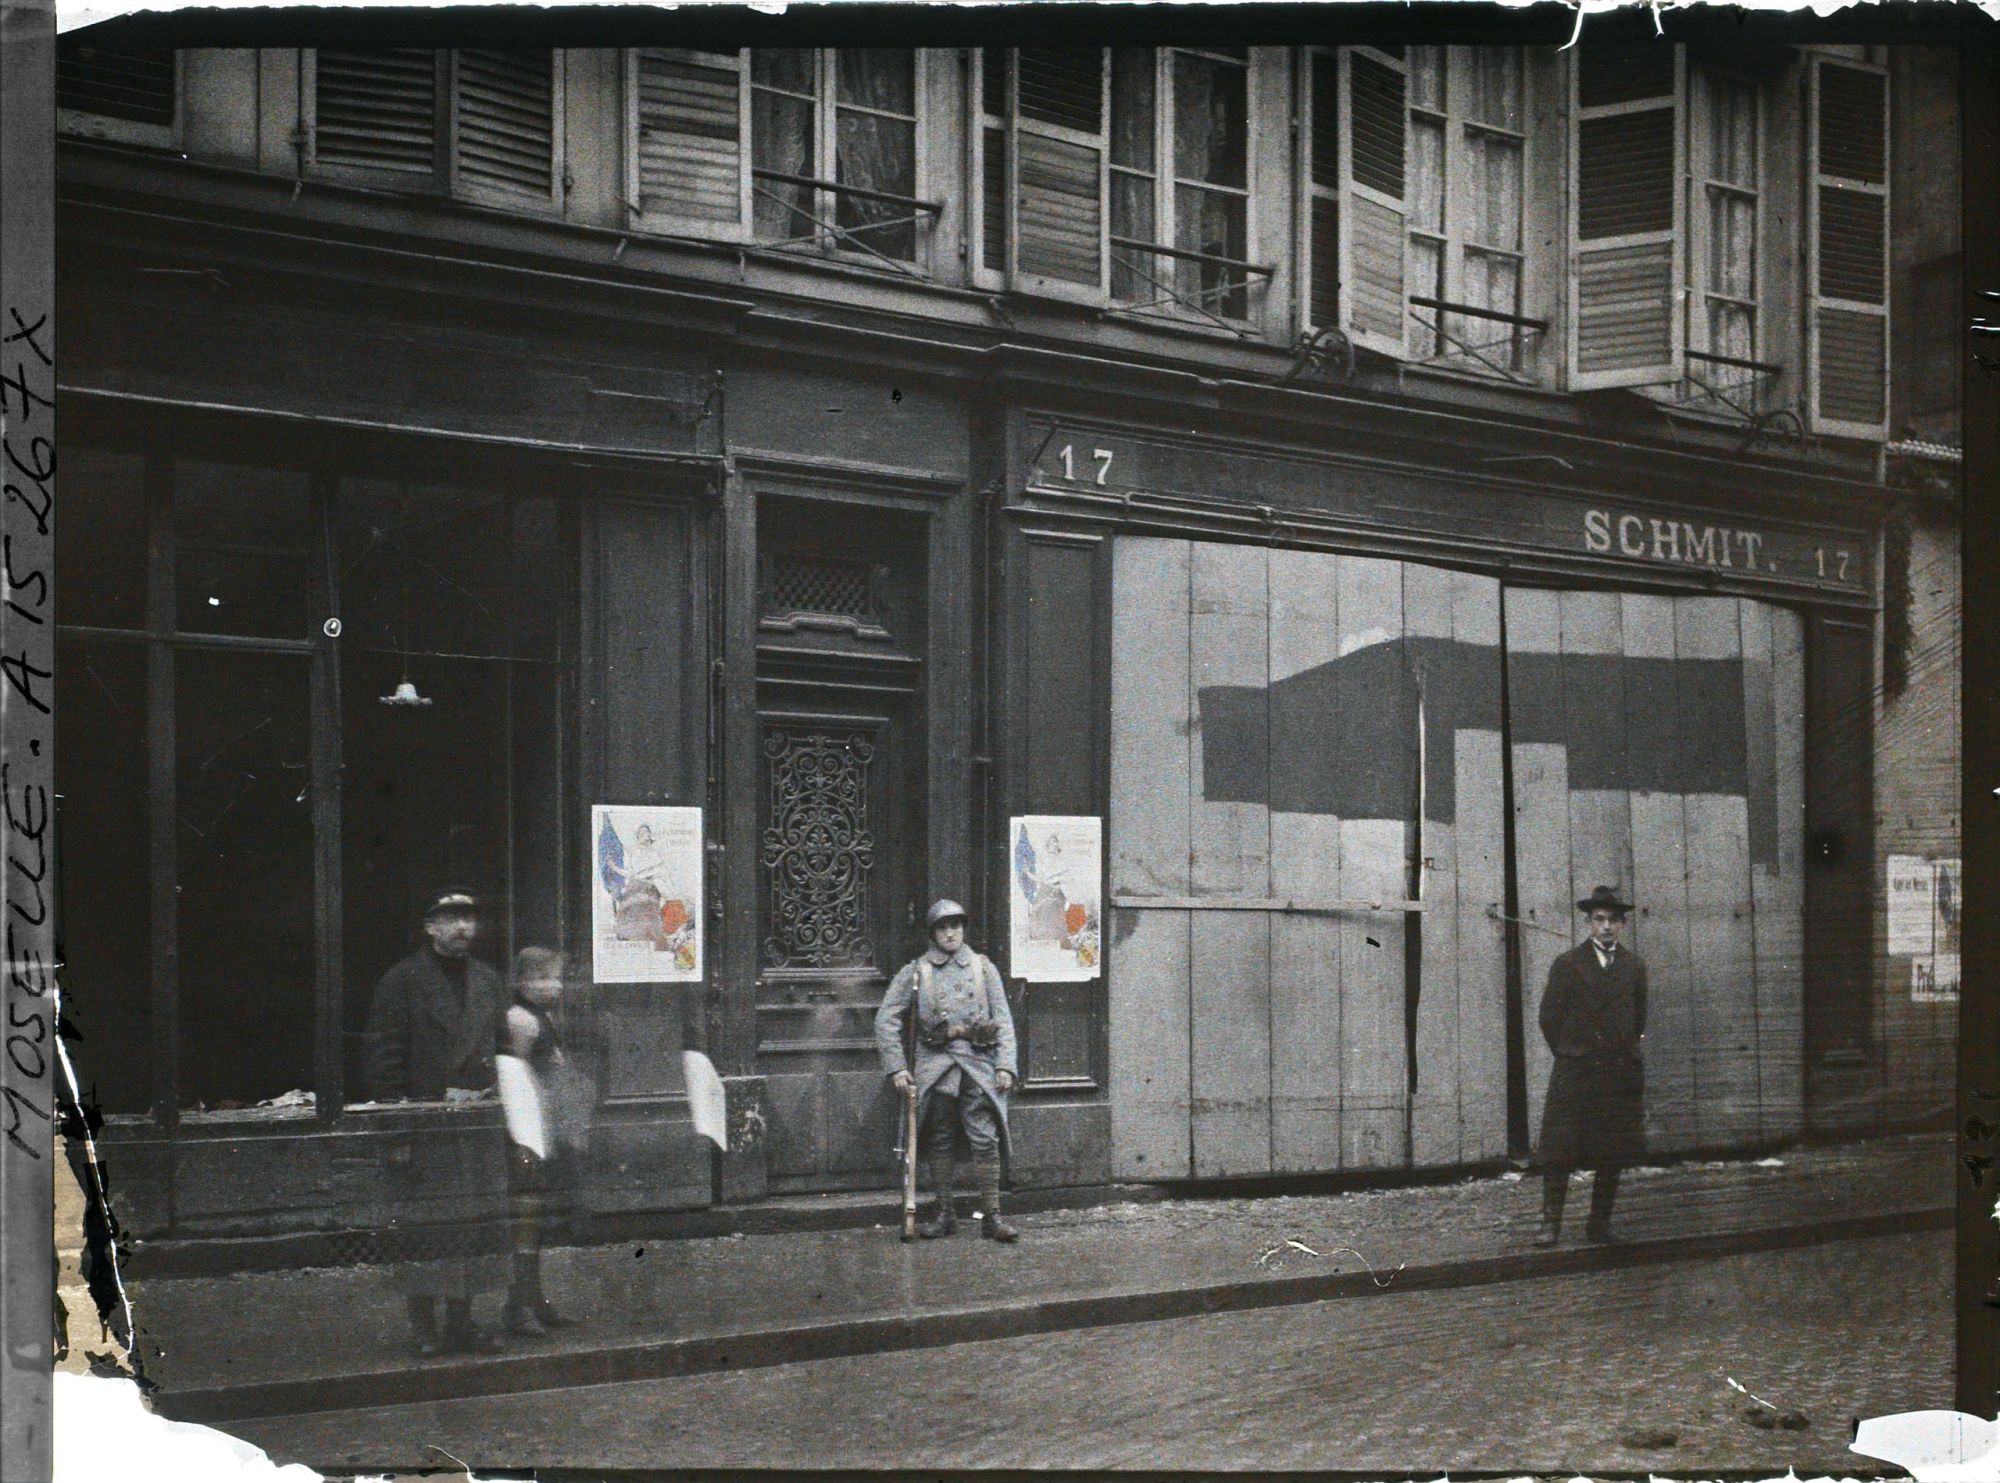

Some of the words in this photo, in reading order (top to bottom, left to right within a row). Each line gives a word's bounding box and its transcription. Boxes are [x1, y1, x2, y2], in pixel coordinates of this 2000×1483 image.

[1059, 444, 1114, 486] 17
[1584, 509, 1777, 573] SCHMIT.
[1814, 545, 1849, 581] 17
